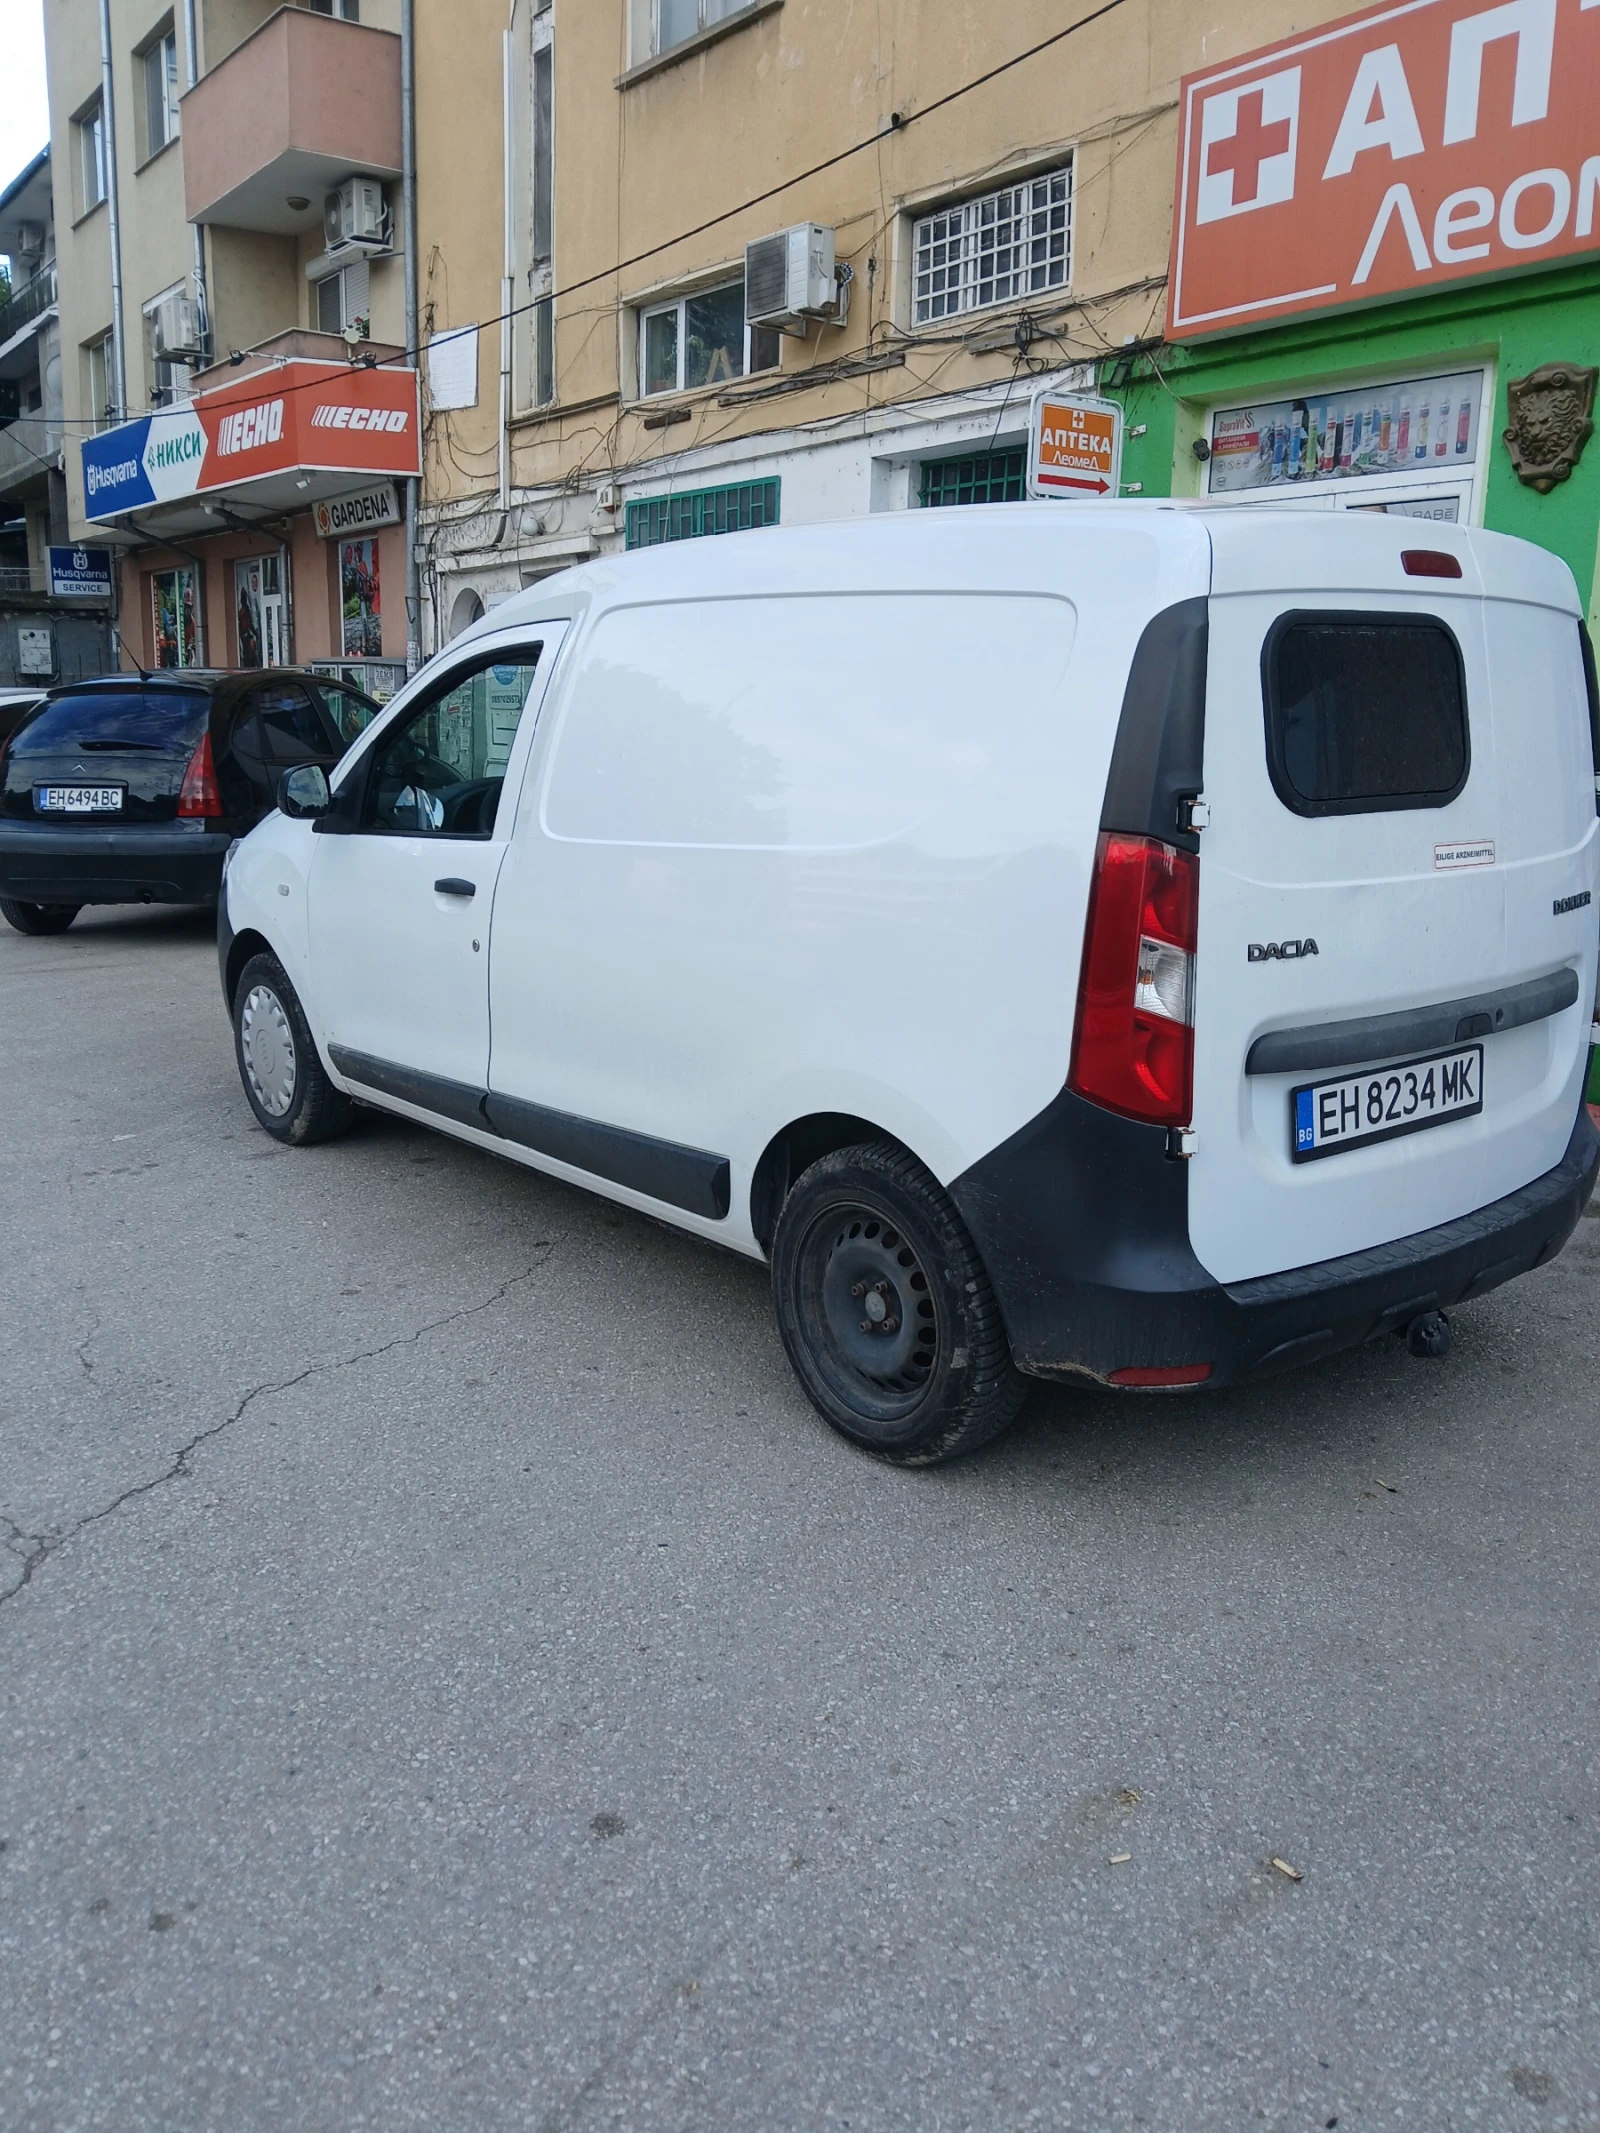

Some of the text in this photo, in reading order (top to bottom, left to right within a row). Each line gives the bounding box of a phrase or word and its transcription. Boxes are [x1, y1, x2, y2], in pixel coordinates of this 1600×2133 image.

[1322, 0, 1600, 180] АП
[230, 398, 284, 453] ECHO
[332, 406, 409, 433] ECHO
[156, 430, 202, 469] НИКСИ
[1041, 427, 1112, 455] АПТЕКА
[95, 458, 138, 488] Husqvarna
[331, 492, 391, 529] GARDENA
[53, 567, 108, 580] Husqvarna
[62, 583, 104, 593] SERVICE
[48, 790, 119, 806] EH 6494 BC
[1436, 852, 1455, 861] EILIGE
[1247, 938, 1319, 962] DACIA
[1319, 1056, 1475, 1139] EH 8234 MK
[1298, 1127, 1313, 1143] BG
